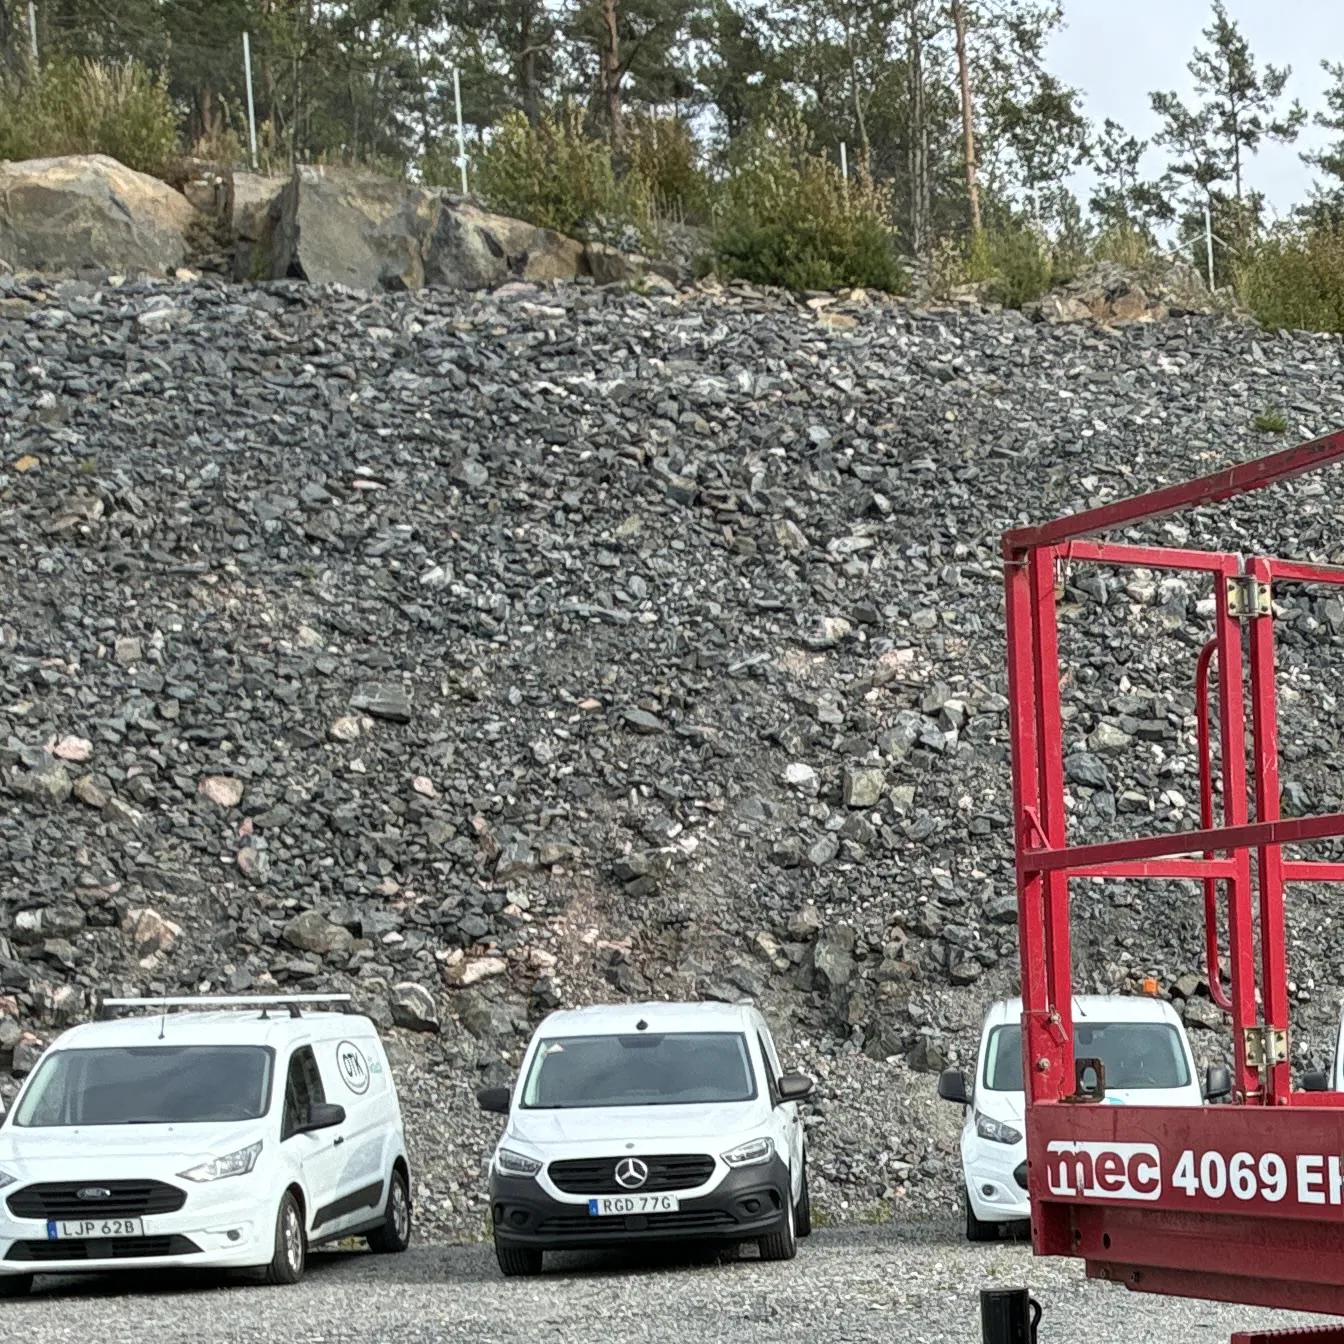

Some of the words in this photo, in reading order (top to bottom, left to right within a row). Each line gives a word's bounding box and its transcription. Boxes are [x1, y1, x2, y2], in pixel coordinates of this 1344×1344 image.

[1047, 1148, 1160, 1195] mec
[1172, 1150, 1288, 1201] 4069
[603, 1199, 634, 1212] RGD
[639, 1196, 671, 1210] 77G
[63, 1222, 95, 1236] LJP
[101, 1221, 134, 1235] 62B
